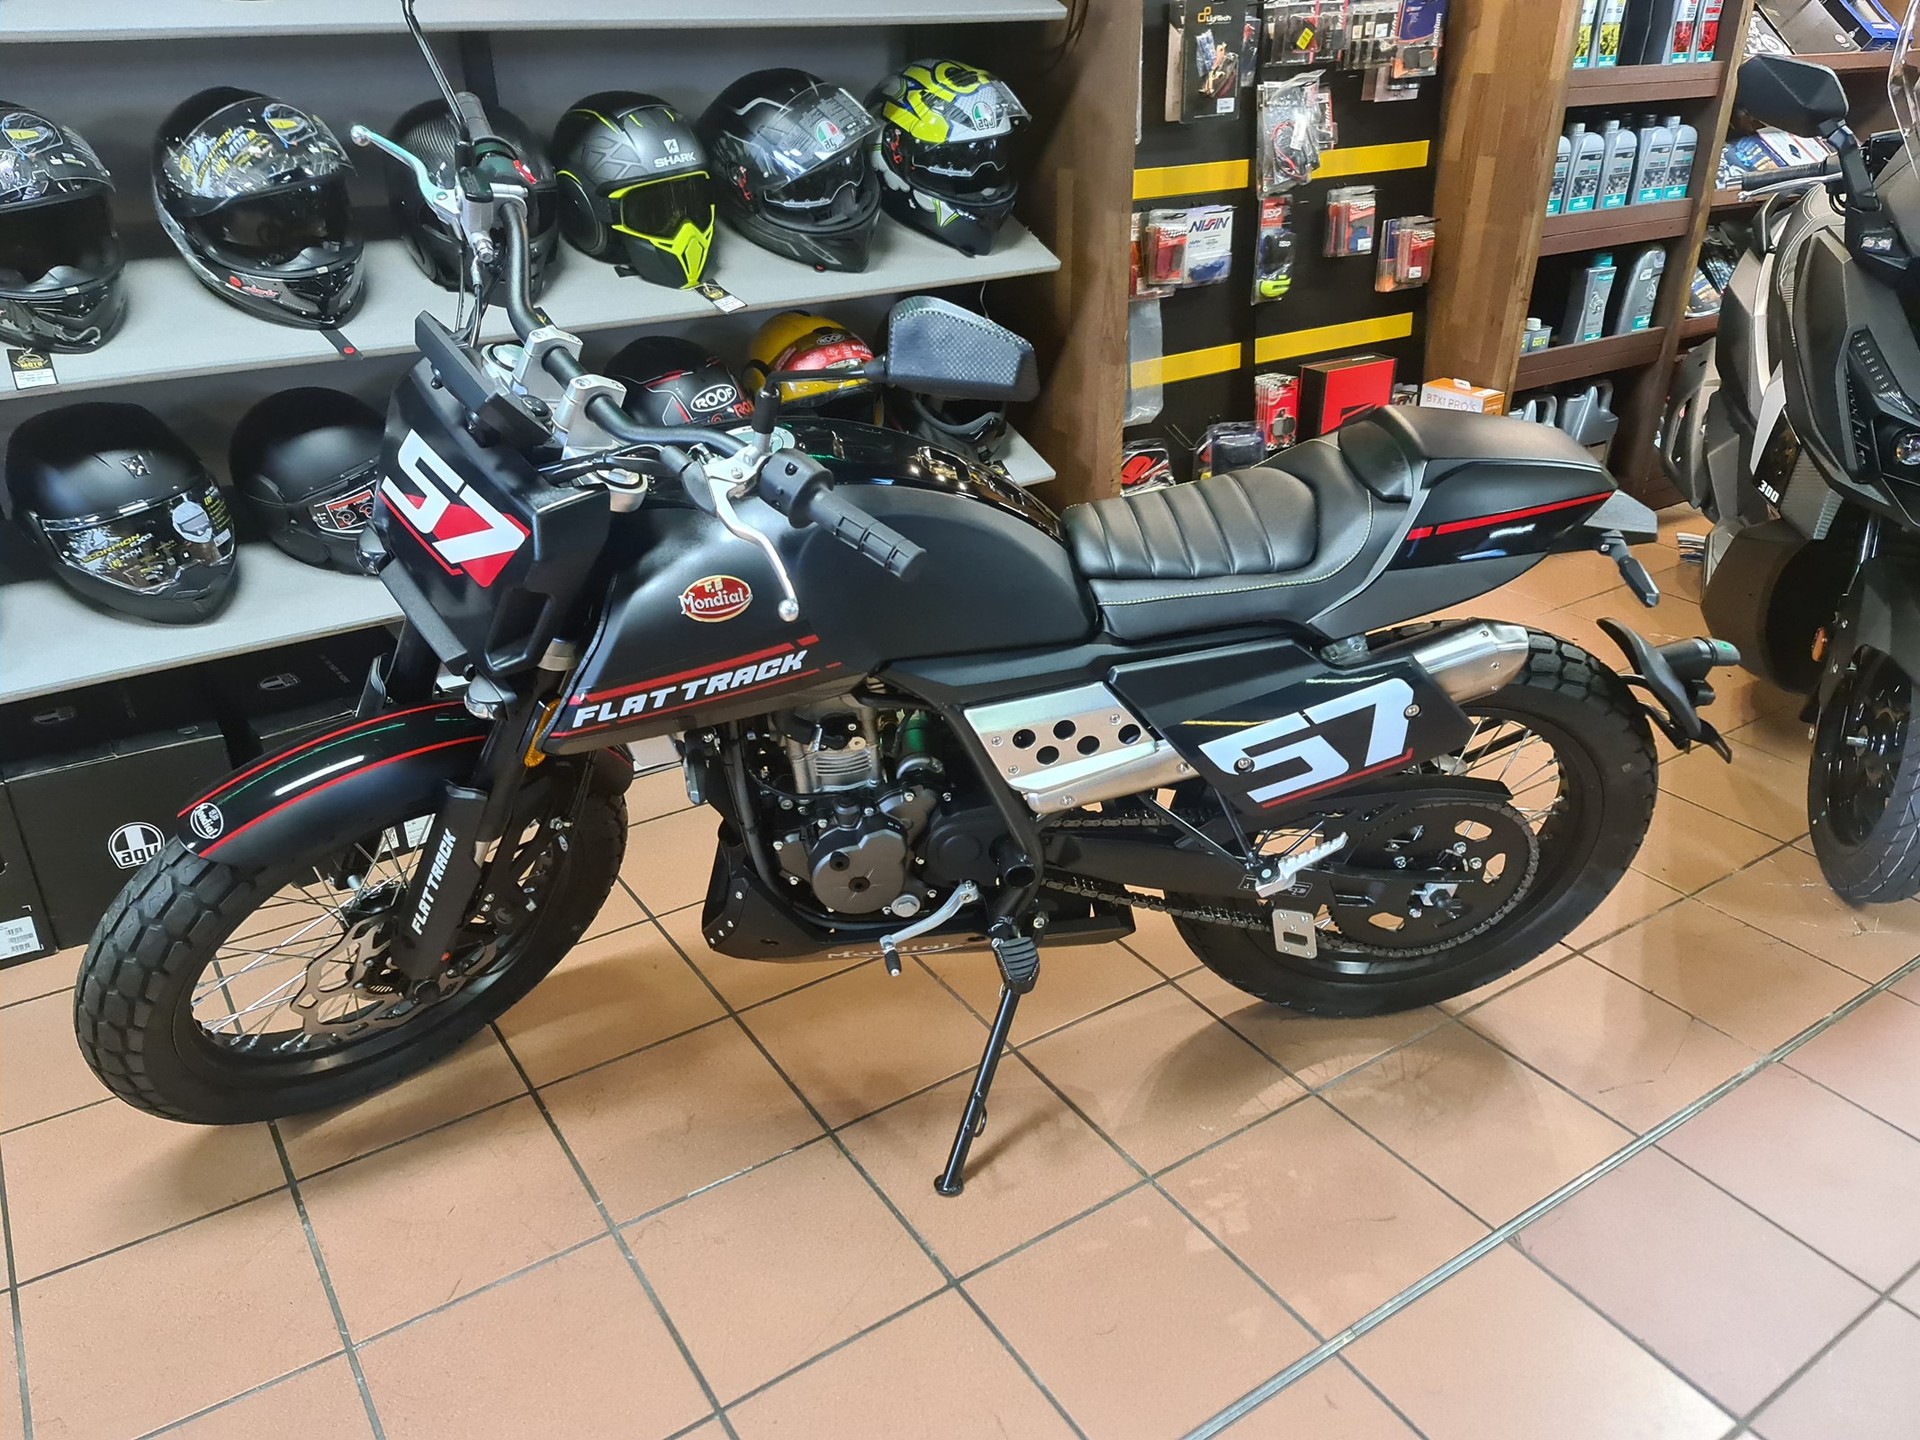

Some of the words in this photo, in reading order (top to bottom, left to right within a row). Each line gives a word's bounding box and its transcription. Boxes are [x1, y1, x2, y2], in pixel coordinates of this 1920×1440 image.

[653, 151, 697, 168] SHARK
[694, 387, 734, 409] ROOF
[1426, 393, 1446, 405] BTX1
[381, 428, 525, 564] 57
[1757, 479, 1780, 503] 300
[83, 533, 141, 564] SCORPION
[130, 532, 154, 548] EXO
[678, 587, 746, 615] Mondial
[572, 686, 677, 729] FLAT
[681, 650, 808, 702] TRACK
[1198, 677, 1415, 804] 57
[194, 804, 219, 837] Mondial
[411, 886, 435, 936] FLAT
[426, 827, 457, 890] TRACK
